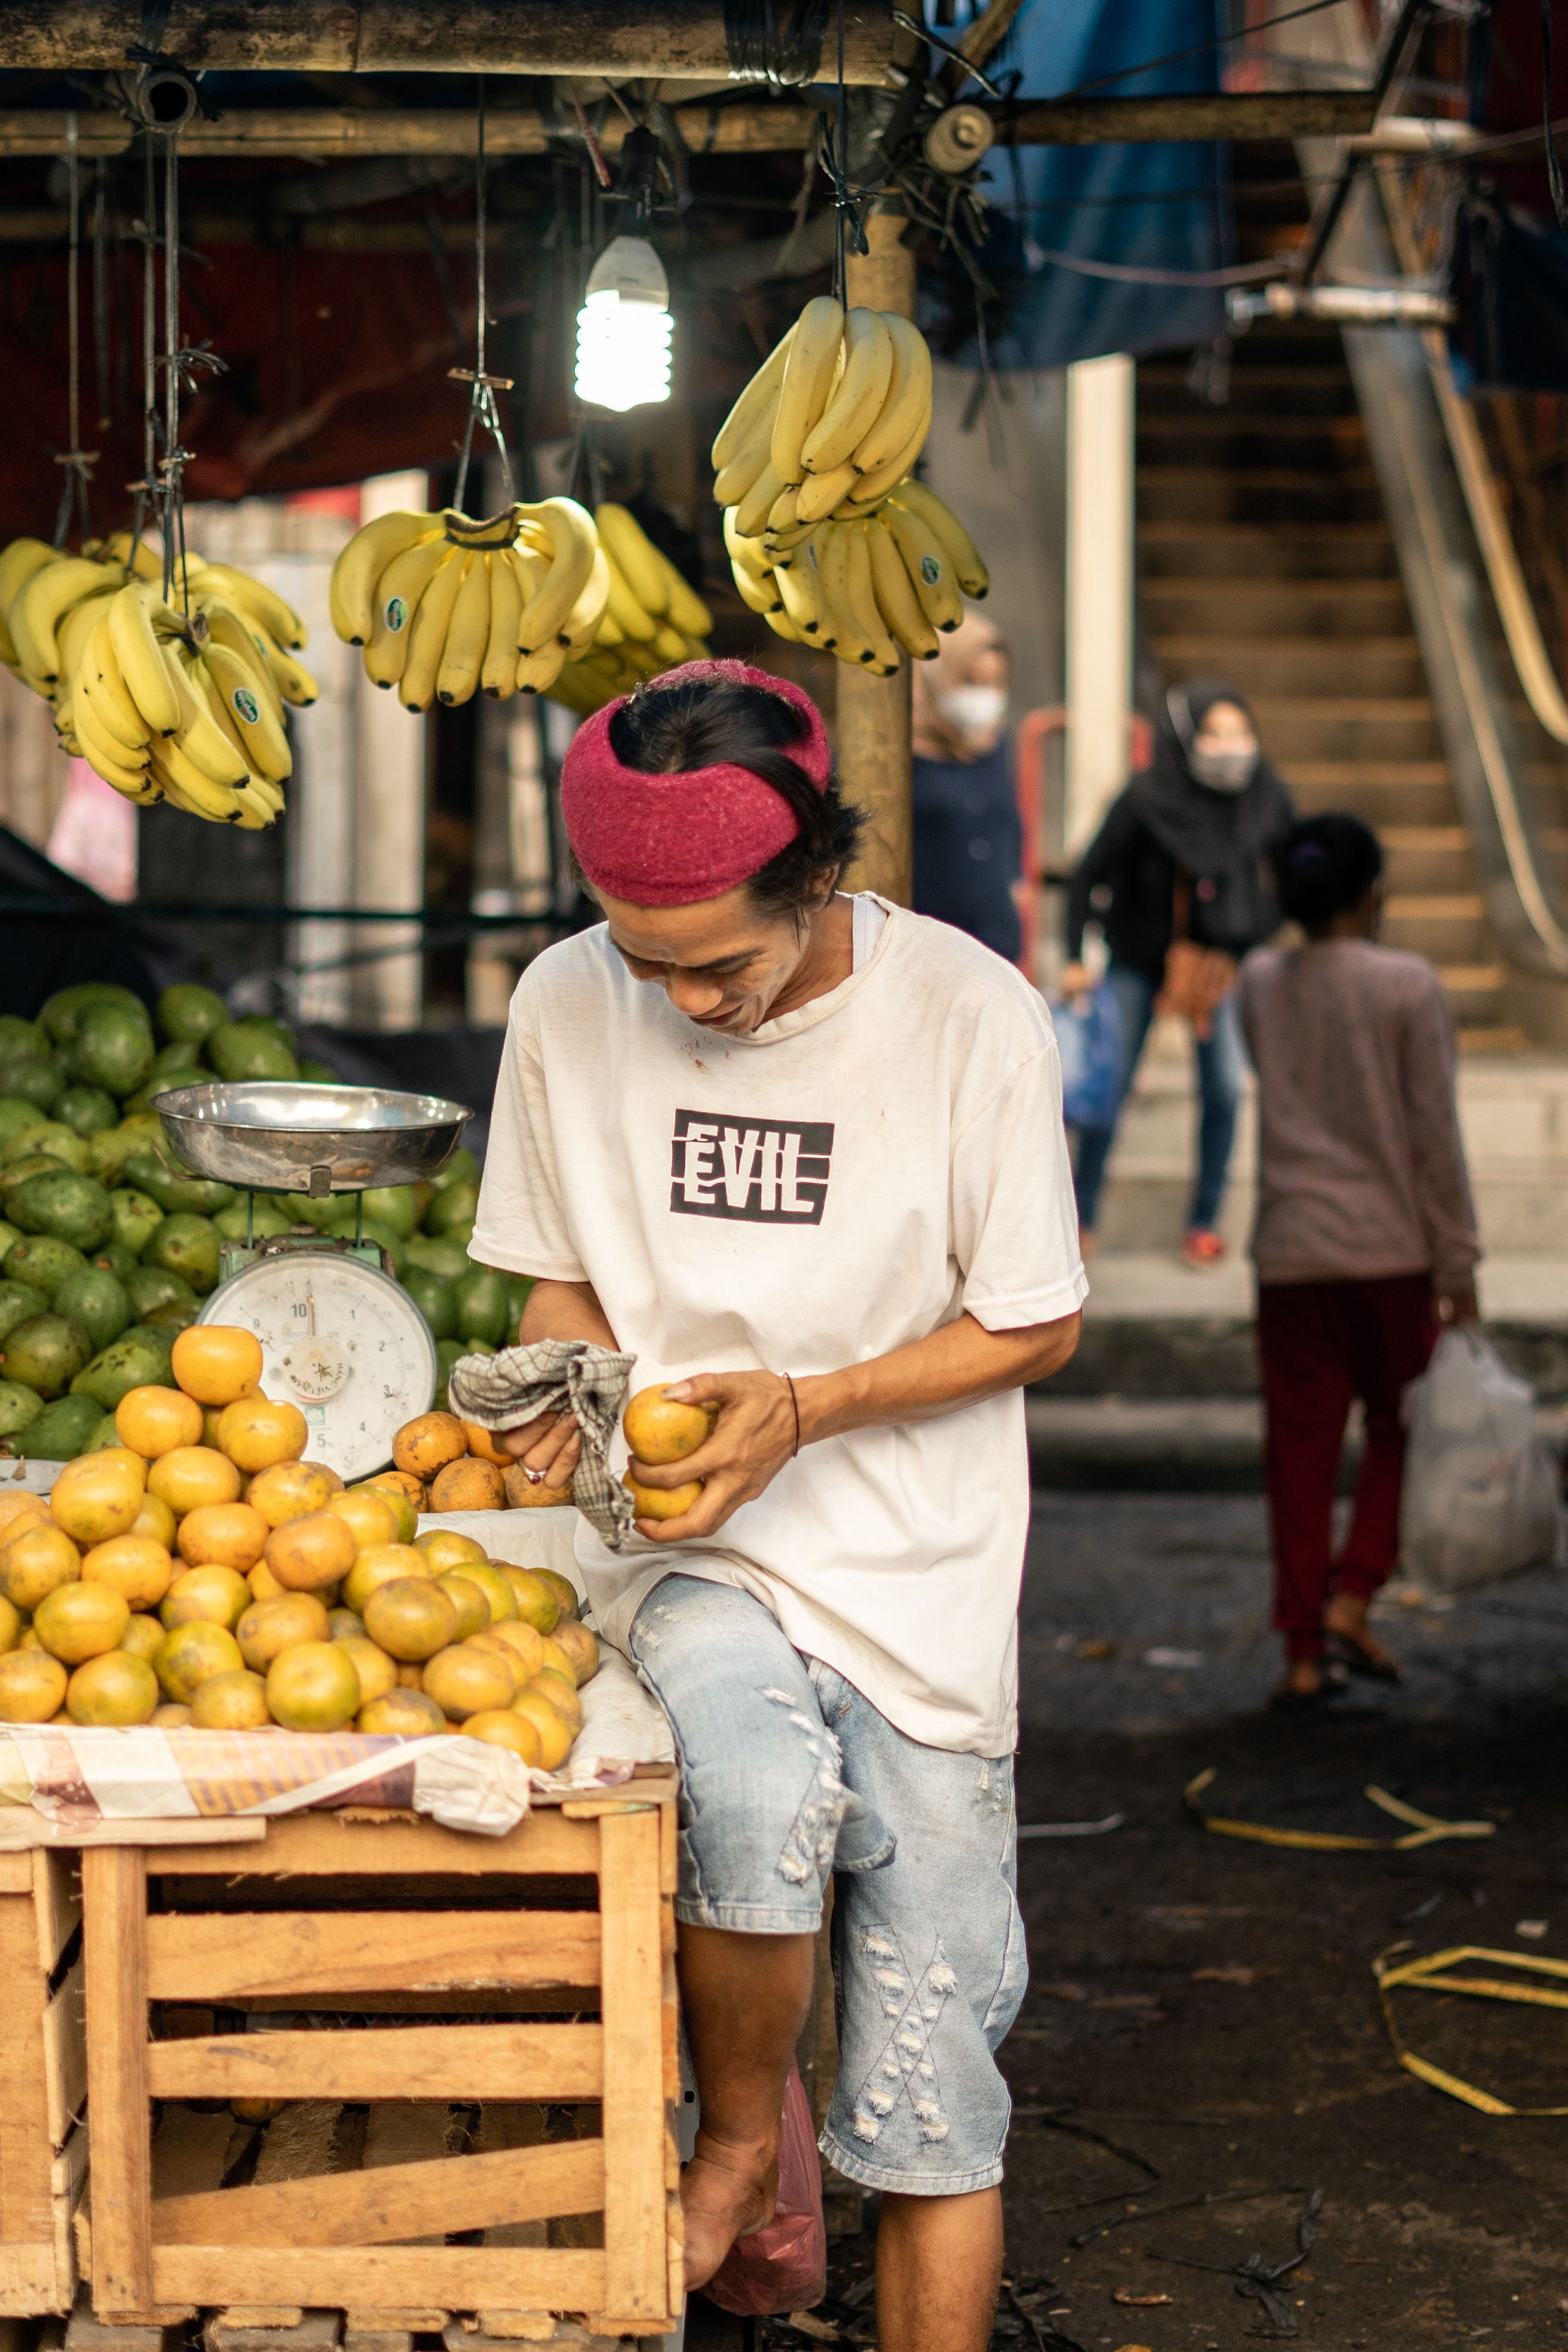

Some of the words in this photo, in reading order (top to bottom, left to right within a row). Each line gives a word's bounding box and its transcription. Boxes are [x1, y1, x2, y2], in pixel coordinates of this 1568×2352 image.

[683, 1121, 815, 1214] EVIL
[291, 1303, 307, 1318] 10
[350, 1309, 355, 1320] 1
[253, 1318, 260, 1330] 9
[379, 1340, 385, 1351] 2
[383, 1385, 390, 1398] 3
[359, 1422, 366, 1432] 4
